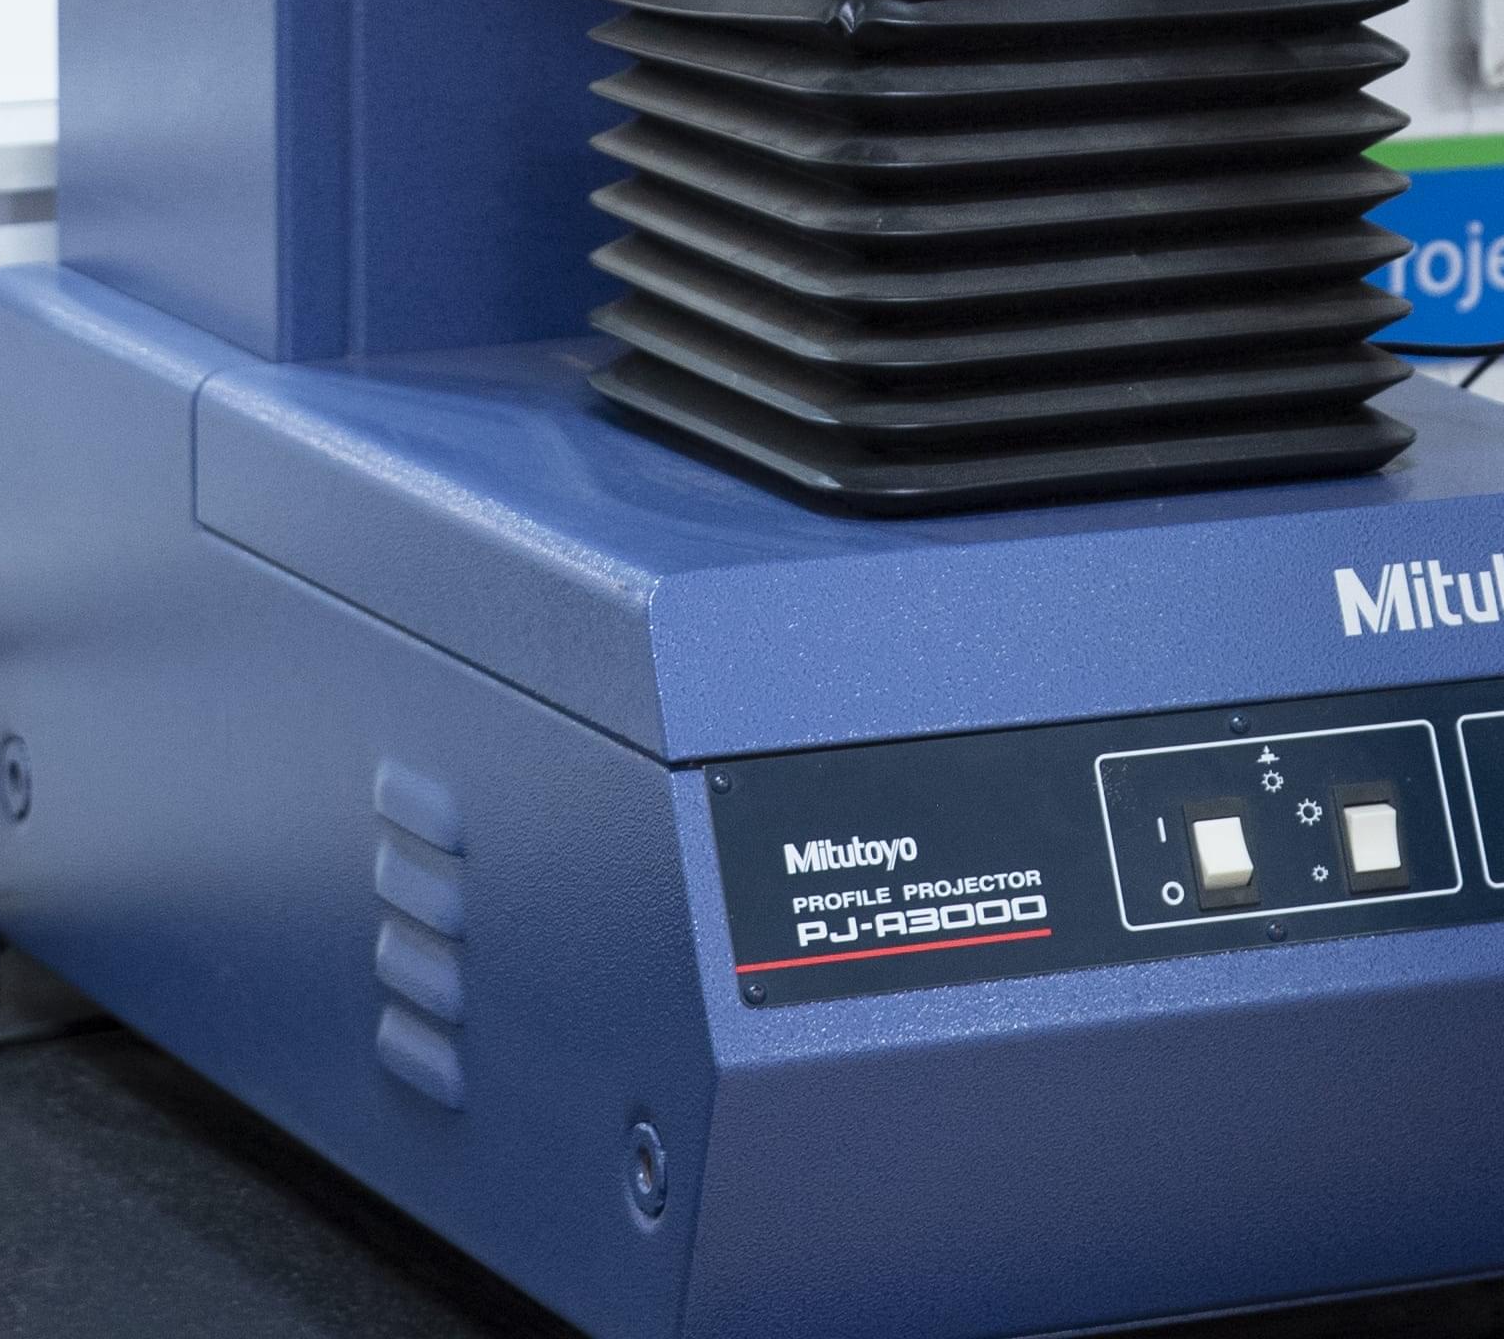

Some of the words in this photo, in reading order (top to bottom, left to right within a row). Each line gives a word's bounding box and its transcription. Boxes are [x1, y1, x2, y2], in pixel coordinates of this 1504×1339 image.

[783, 835, 918, 874] Mitutoyo
[792, 887, 892, 915] PROFILE
[902, 869, 1042, 902] PROJECTOR
[797, 895, 1048, 947] PJ-A3000
